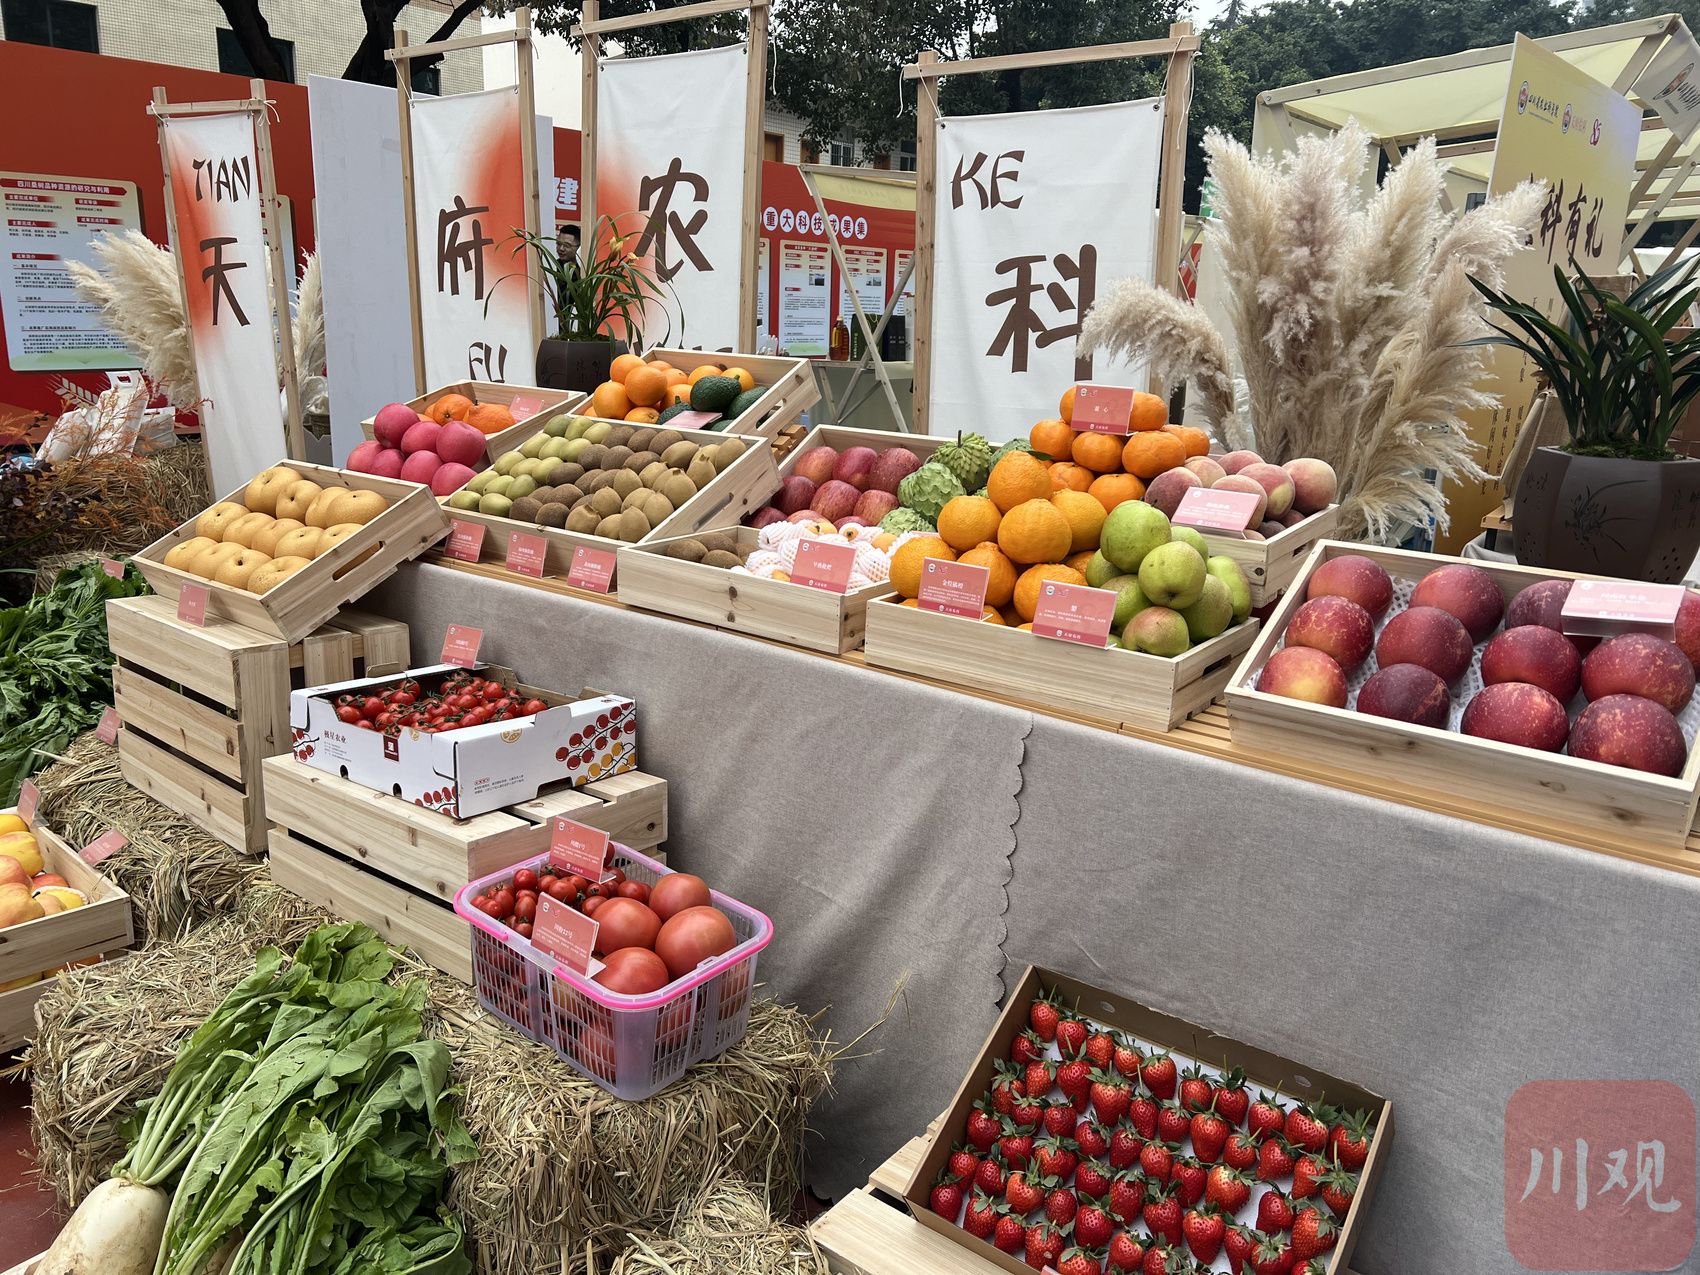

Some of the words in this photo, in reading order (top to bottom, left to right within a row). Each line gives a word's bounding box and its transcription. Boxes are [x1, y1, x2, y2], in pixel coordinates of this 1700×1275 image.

[192, 155, 251, 203] TIAN
[633, 156, 715, 283] 农
[951, 150, 1026, 211] KE
[1525, 171, 1604, 266] 科有礼
[200, 237, 251, 327] 天
[437, 195, 494, 301] 府
[985, 243, 1098, 382] 科
[469, 341, 508, 383] FU
